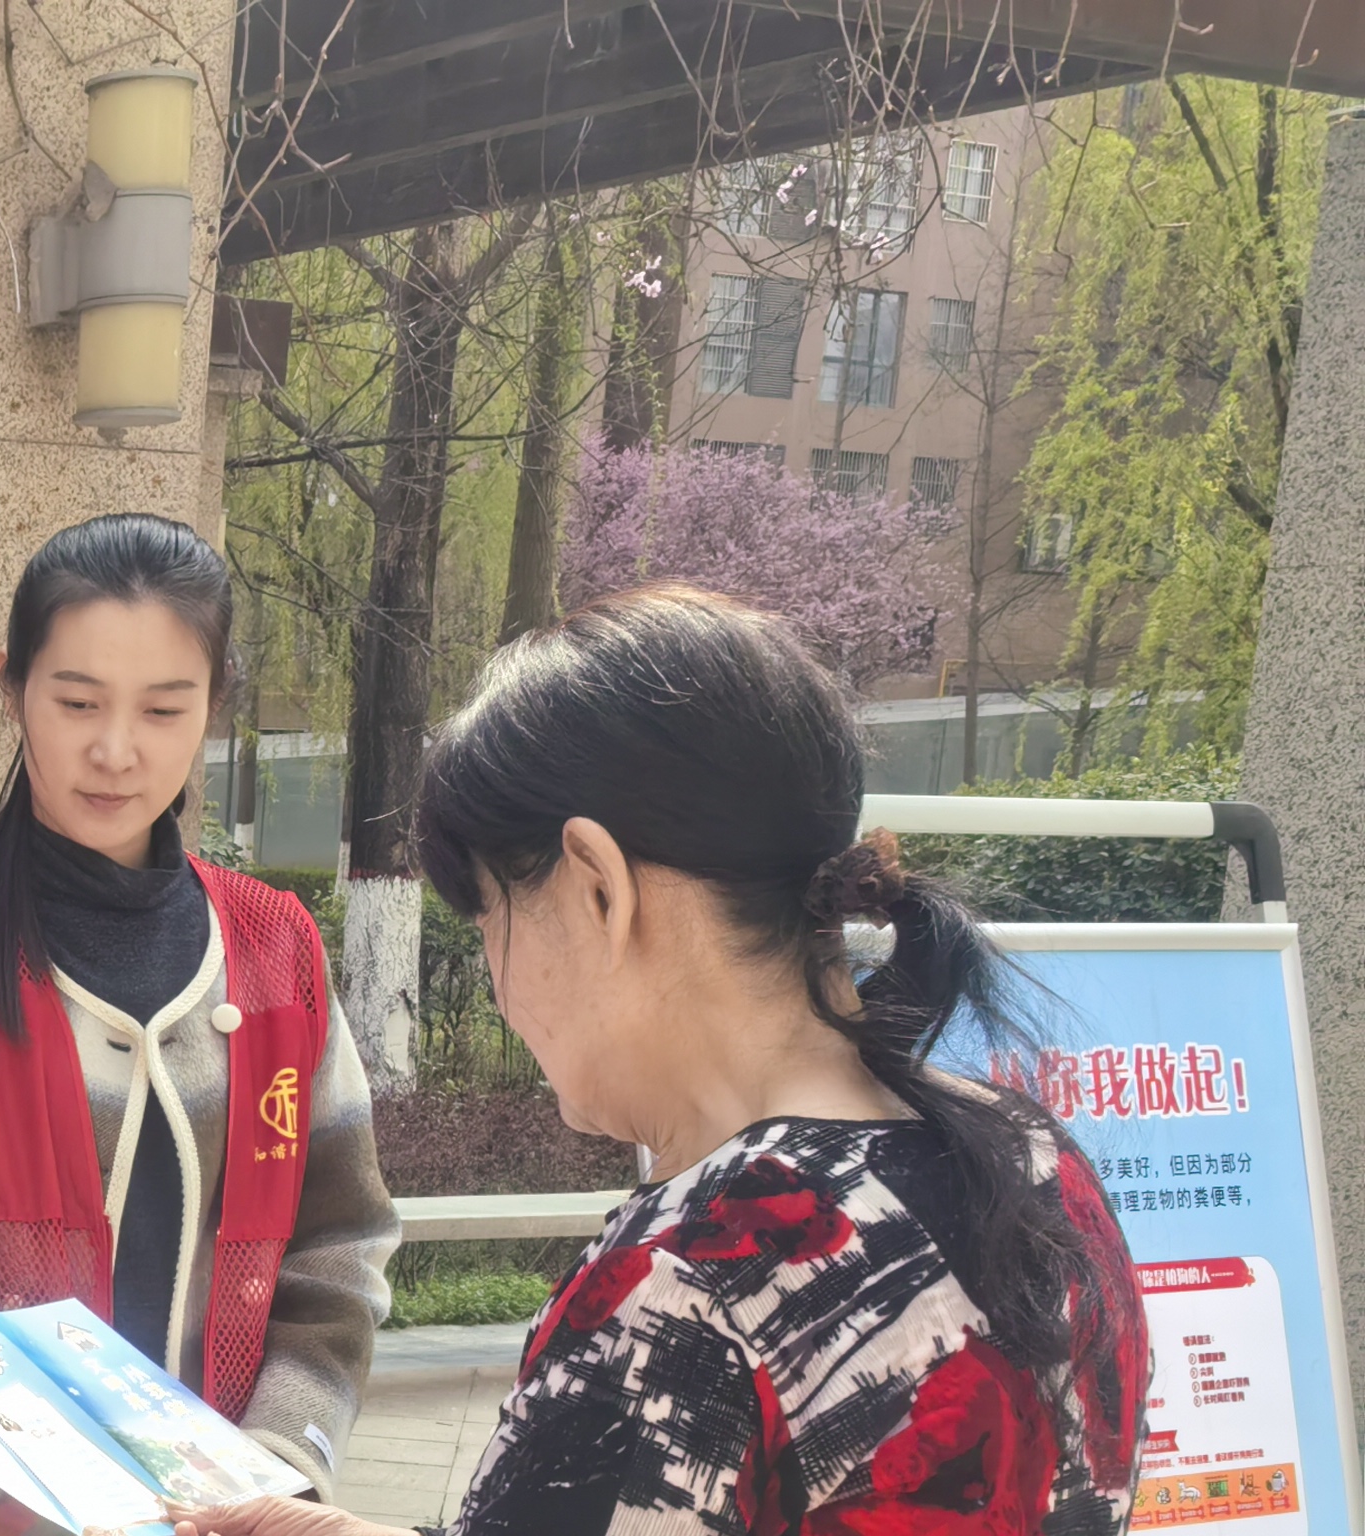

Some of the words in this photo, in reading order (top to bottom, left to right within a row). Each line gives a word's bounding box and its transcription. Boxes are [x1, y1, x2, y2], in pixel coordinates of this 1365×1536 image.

[1091, 1152, 1252, 1181] 多美好，但因为部分
[1137, 1266, 1211, 1288] 你是怕狗的人
